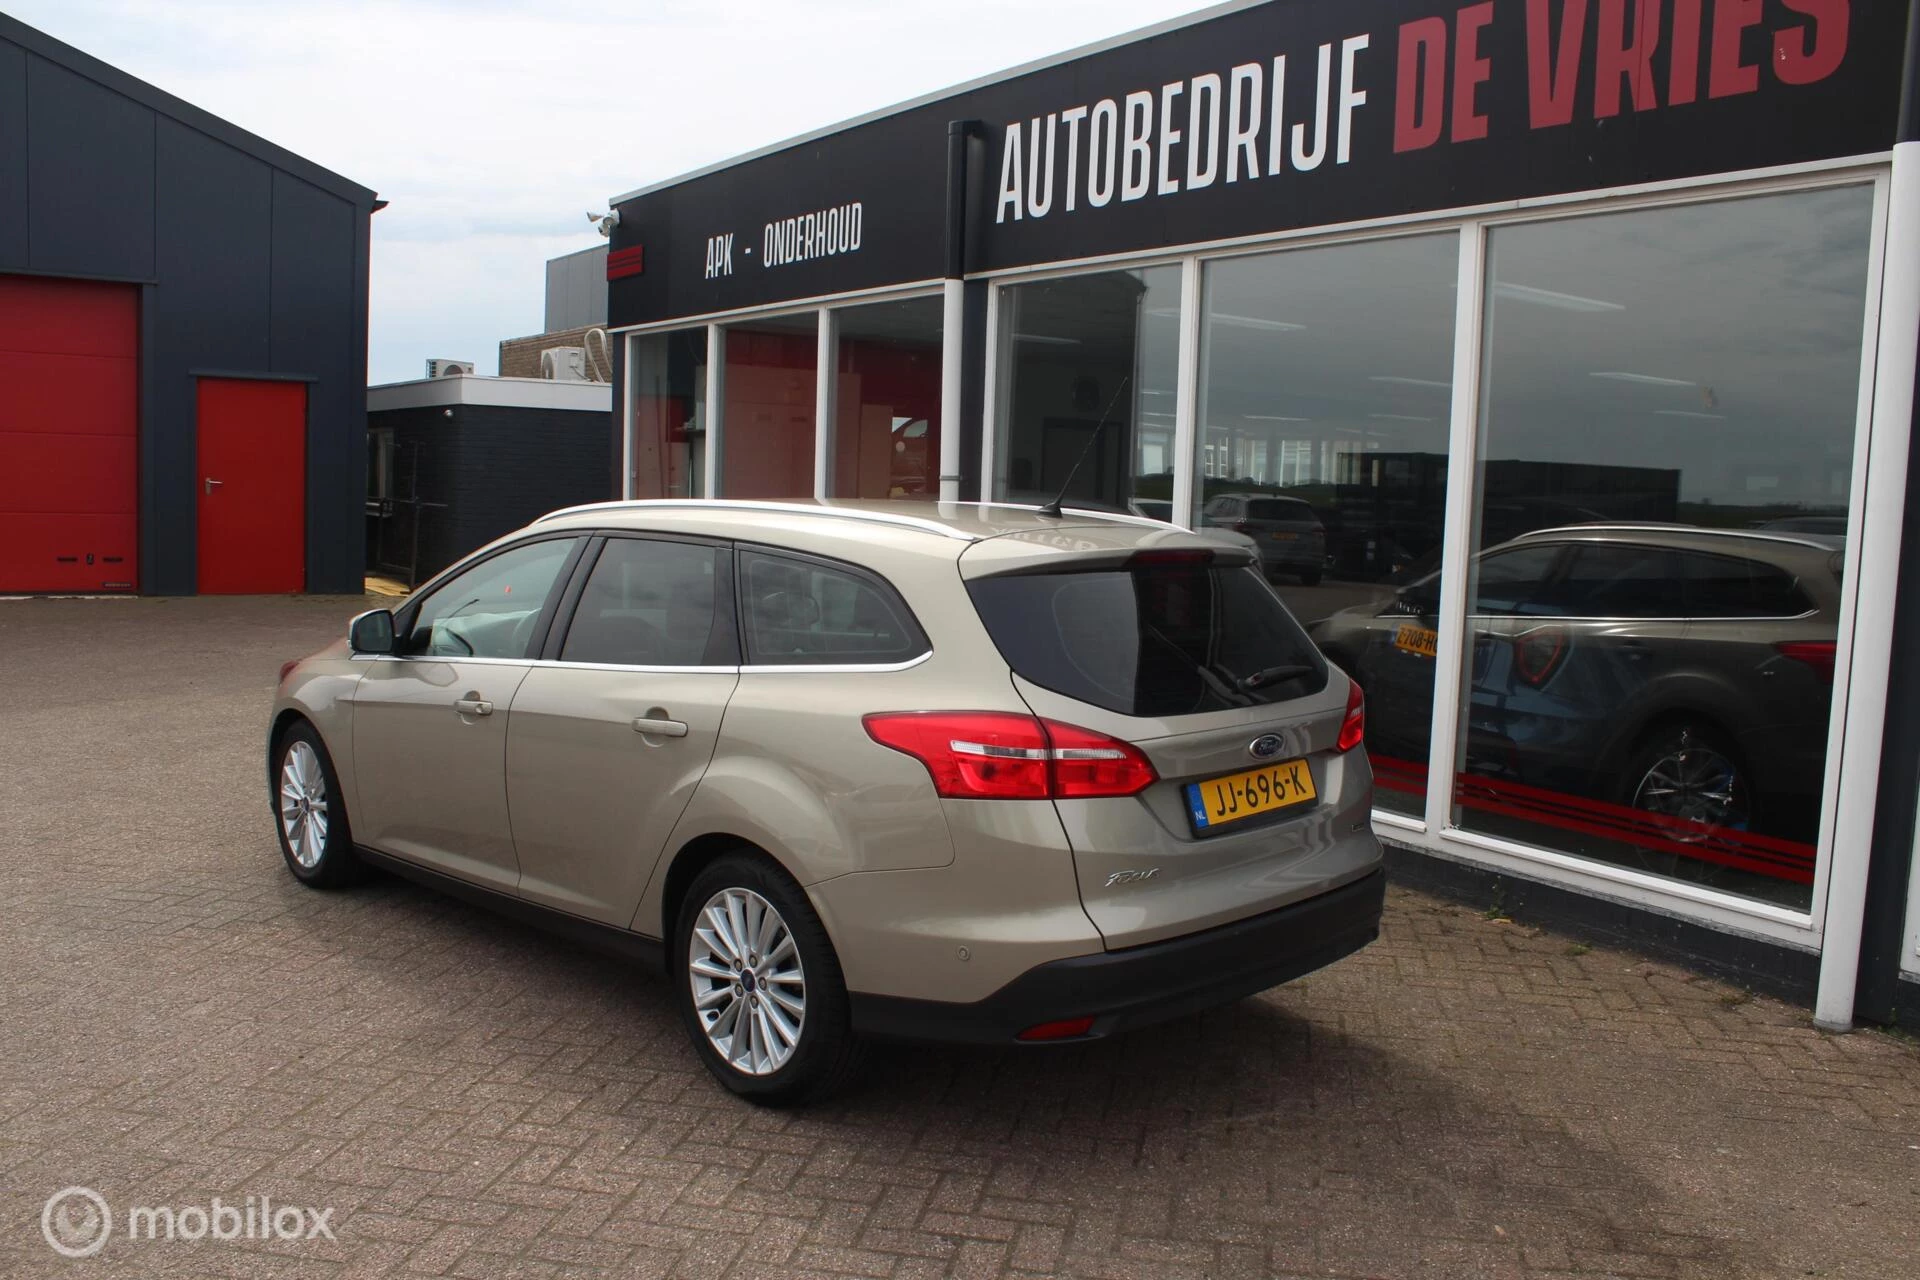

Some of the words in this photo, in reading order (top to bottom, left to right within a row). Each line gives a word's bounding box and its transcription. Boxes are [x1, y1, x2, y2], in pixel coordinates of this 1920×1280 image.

[996, 33, 1370, 224] AUTOBEDRIJF
[1393, 0, 1494, 153] DE
[1525, 0, 1850, 130] VRIES
[705, 232, 734, 279] APK
[763, 202, 863, 268] ONDERHOUD
[1195, 809, 1206, 821] NL
[1216, 766, 1307, 816] JJ-696-K
